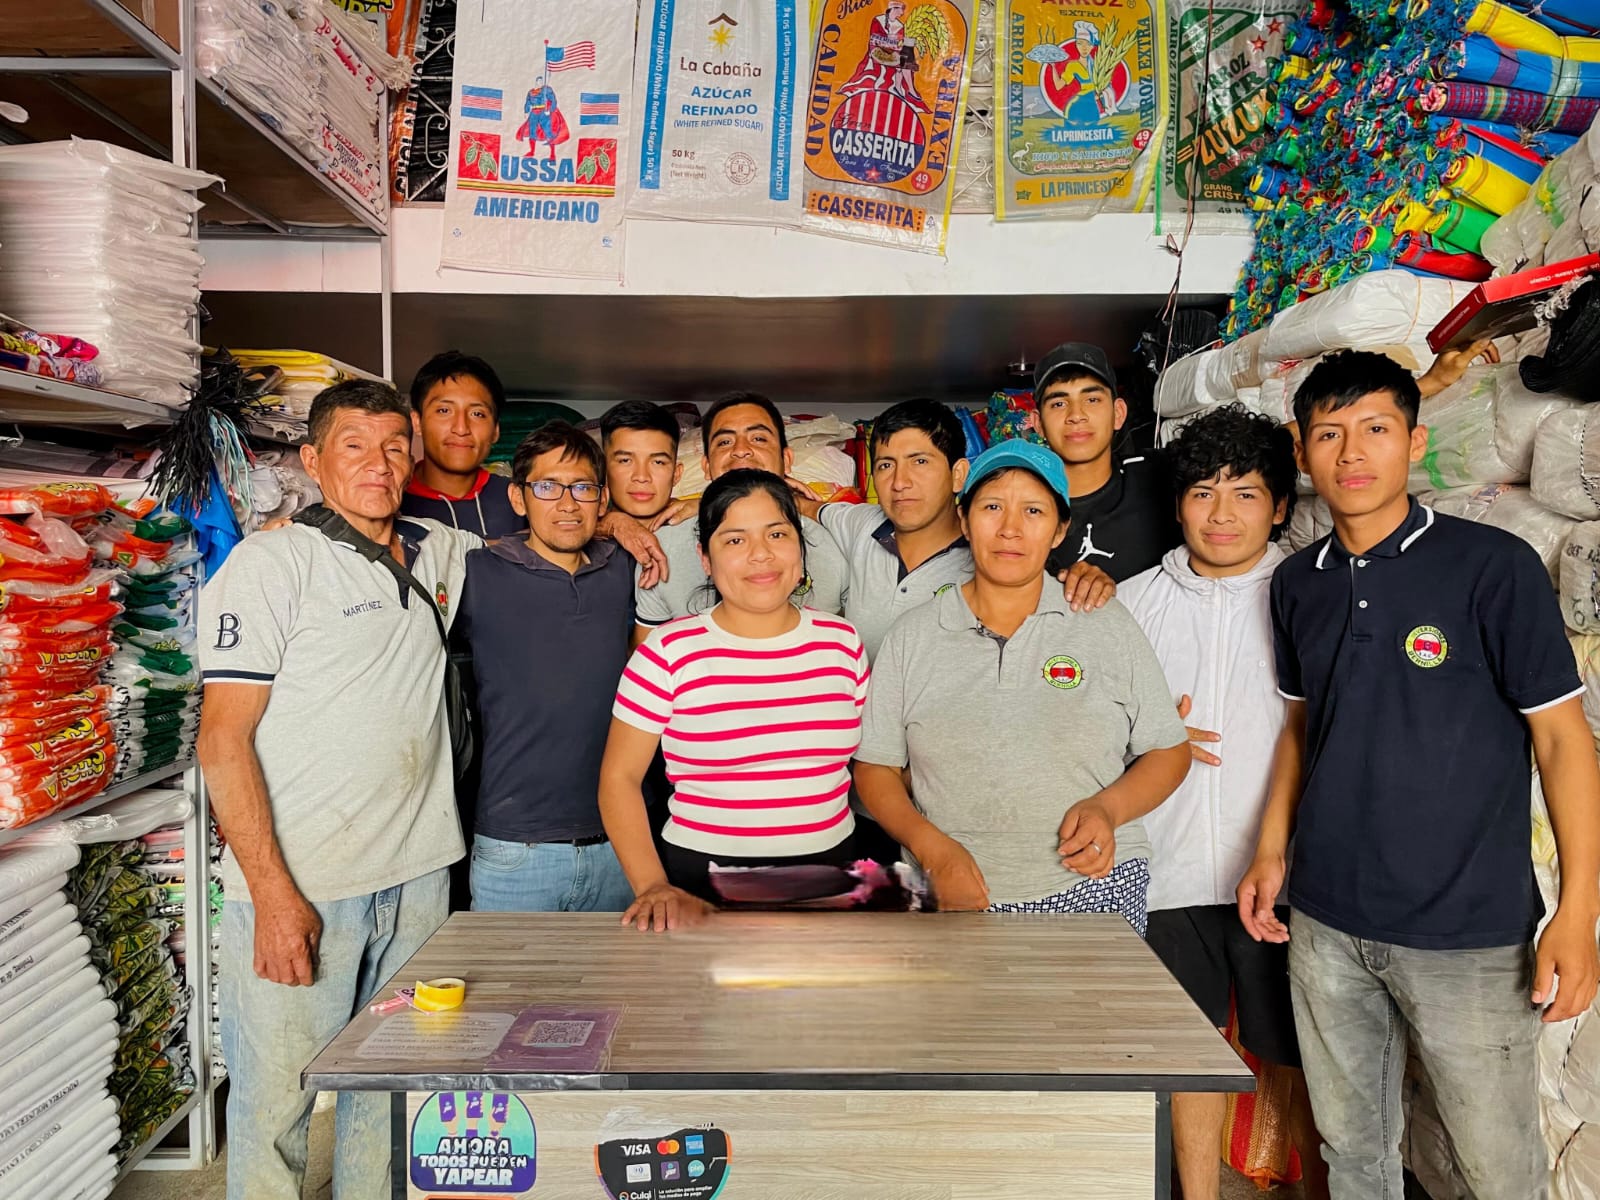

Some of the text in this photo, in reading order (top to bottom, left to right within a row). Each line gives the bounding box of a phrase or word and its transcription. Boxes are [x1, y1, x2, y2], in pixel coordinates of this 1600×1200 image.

[1059, 9, 1105, 17] EXTRA
[1170, 16, 1178, 66] ARROZ
[680, 57, 761, 77] La Cabaña
[1009, 12, 1025, 140] ARROZ EXTRA
[1137, 16, 1154, 128] ARROZ EXTRA
[691, 86, 751, 100] AZÚCAR
[806, 24, 841, 156] CALIDAD
[681, 104, 758, 116] REFINADO
[927, 55, 960, 174] EXTRA
[674, 119, 763, 132] (WHITE REFINED SUGAR)
[776, 116, 786, 162] REFINADO
[1052, 128, 1113, 142] LA PRINCESITA
[1136, 131, 1149, 141] 49
[684, 150, 695, 160] kg
[832, 129, 915, 169] CASSERITA
[501, 155, 574, 183] USSA
[1165, 136, 1174, 187] EXTRA
[916, 173, 929, 183] 49
[1041, 182, 1056, 198] LA
[474, 196, 600, 224] AMERICANO
[817, 194, 915, 228] CASSERITA
[342, 599, 383, 618] MARTÍNEZ
[213, 612, 242, 650] B
[438, 1138, 509, 1155] AHORA
[621, 1144, 651, 1156] VISA
[420, 1155, 527, 1168] TODOS PUEDEN
[434, 1168, 513, 1185] YAPEAR
[631, 1190, 652, 1200] Culqi
